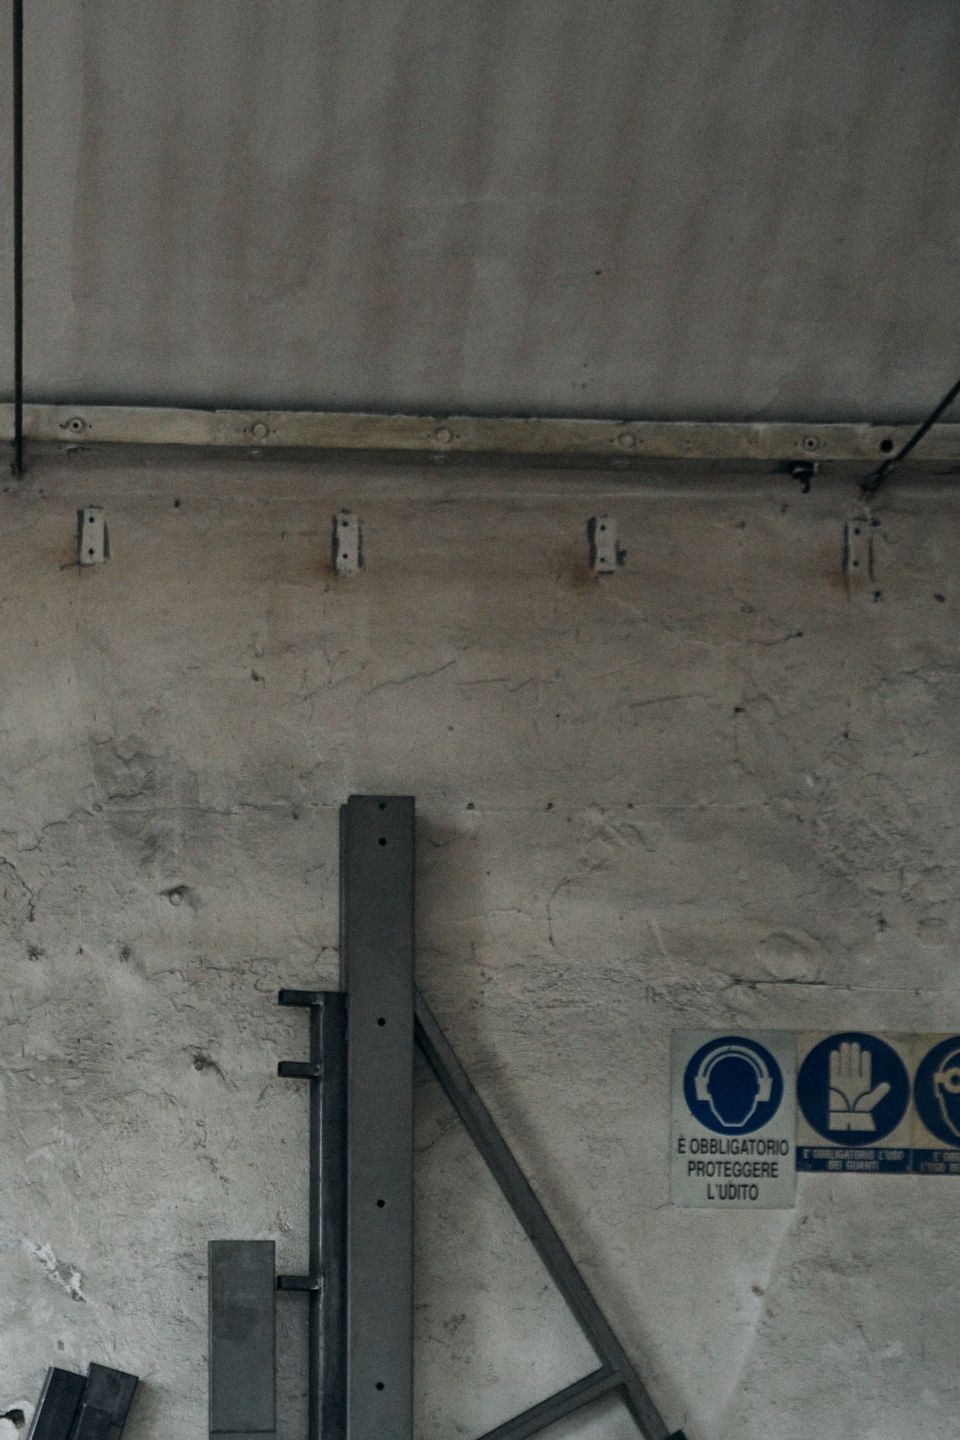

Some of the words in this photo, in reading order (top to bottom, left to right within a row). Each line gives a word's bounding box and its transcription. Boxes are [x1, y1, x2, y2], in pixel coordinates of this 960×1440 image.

[690, 1138, 789, 1156] OBBLIGATORIO
[687, 1160, 778, 1178] PROTEGGERE
[707, 1183, 758, 1200] L'UDITO
